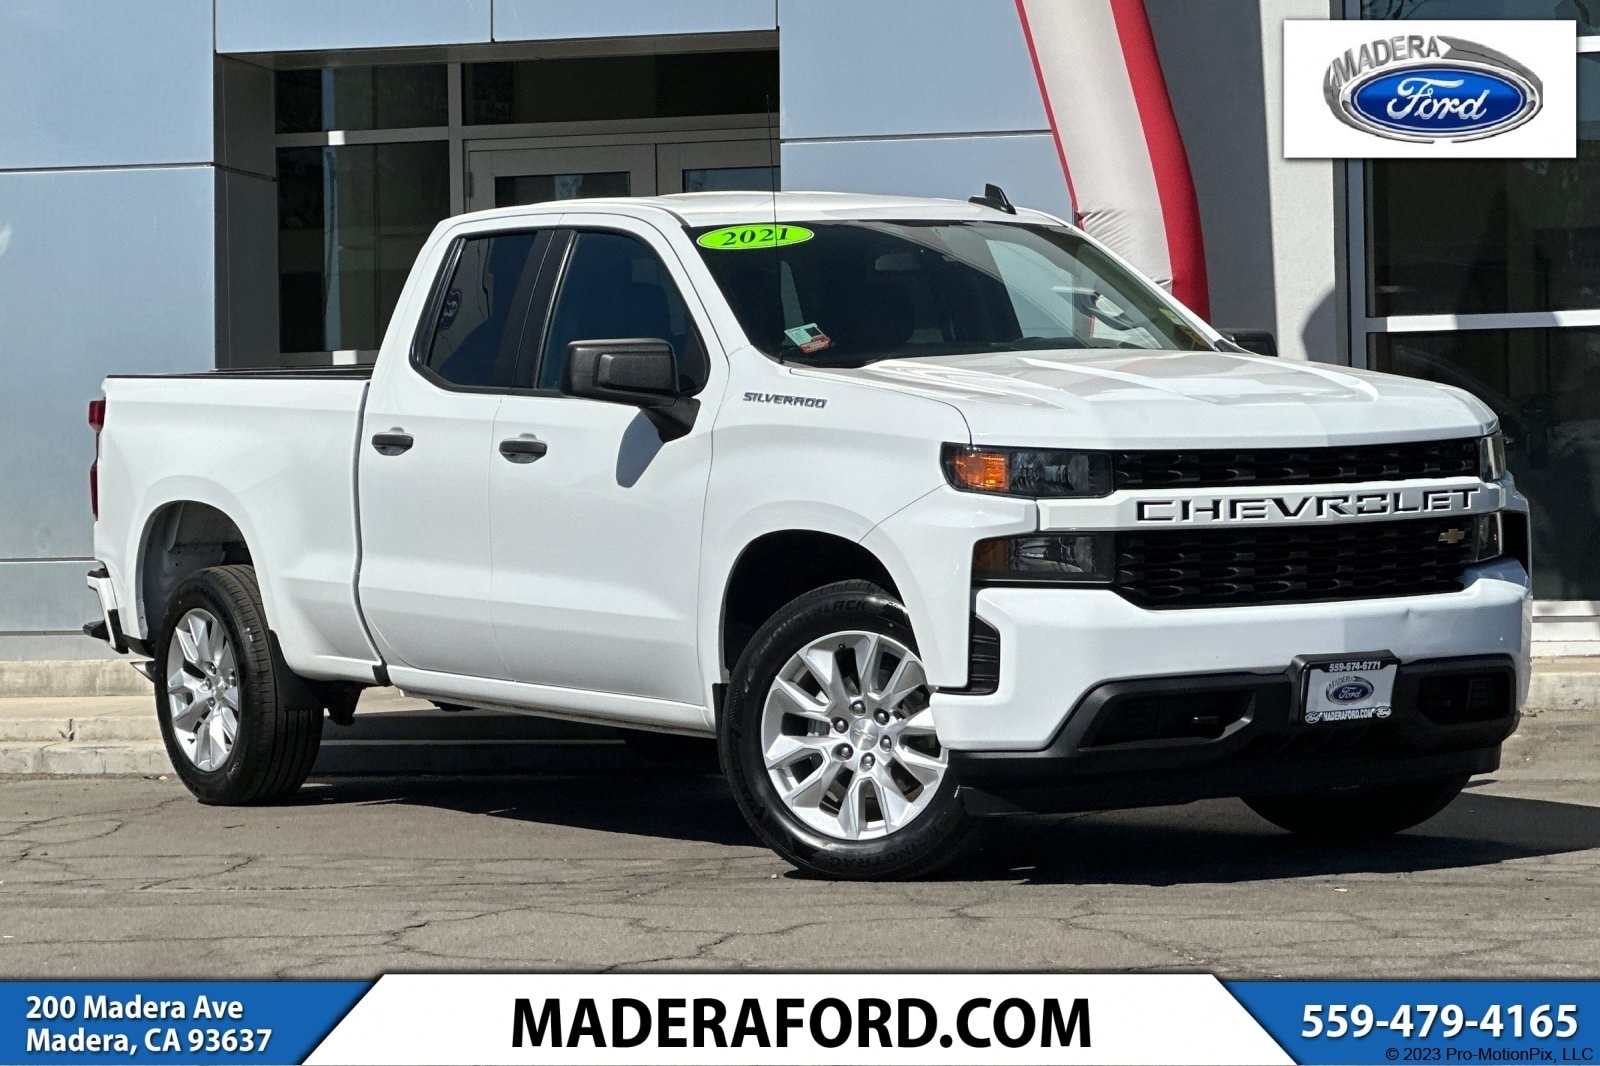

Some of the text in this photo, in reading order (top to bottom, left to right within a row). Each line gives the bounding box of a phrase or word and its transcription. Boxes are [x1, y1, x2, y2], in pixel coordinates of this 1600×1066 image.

[721, 227, 789, 246] 2021
[743, 391, 828, 409] SILVERADO
[1136, 487, 1482, 522] CHEVROLET
[1329, 661, 1381, 672] 559-674-6771
[1338, 686, 1363, 699] Ford
[1323, 708, 1374, 722] MADERAFORD.COM
